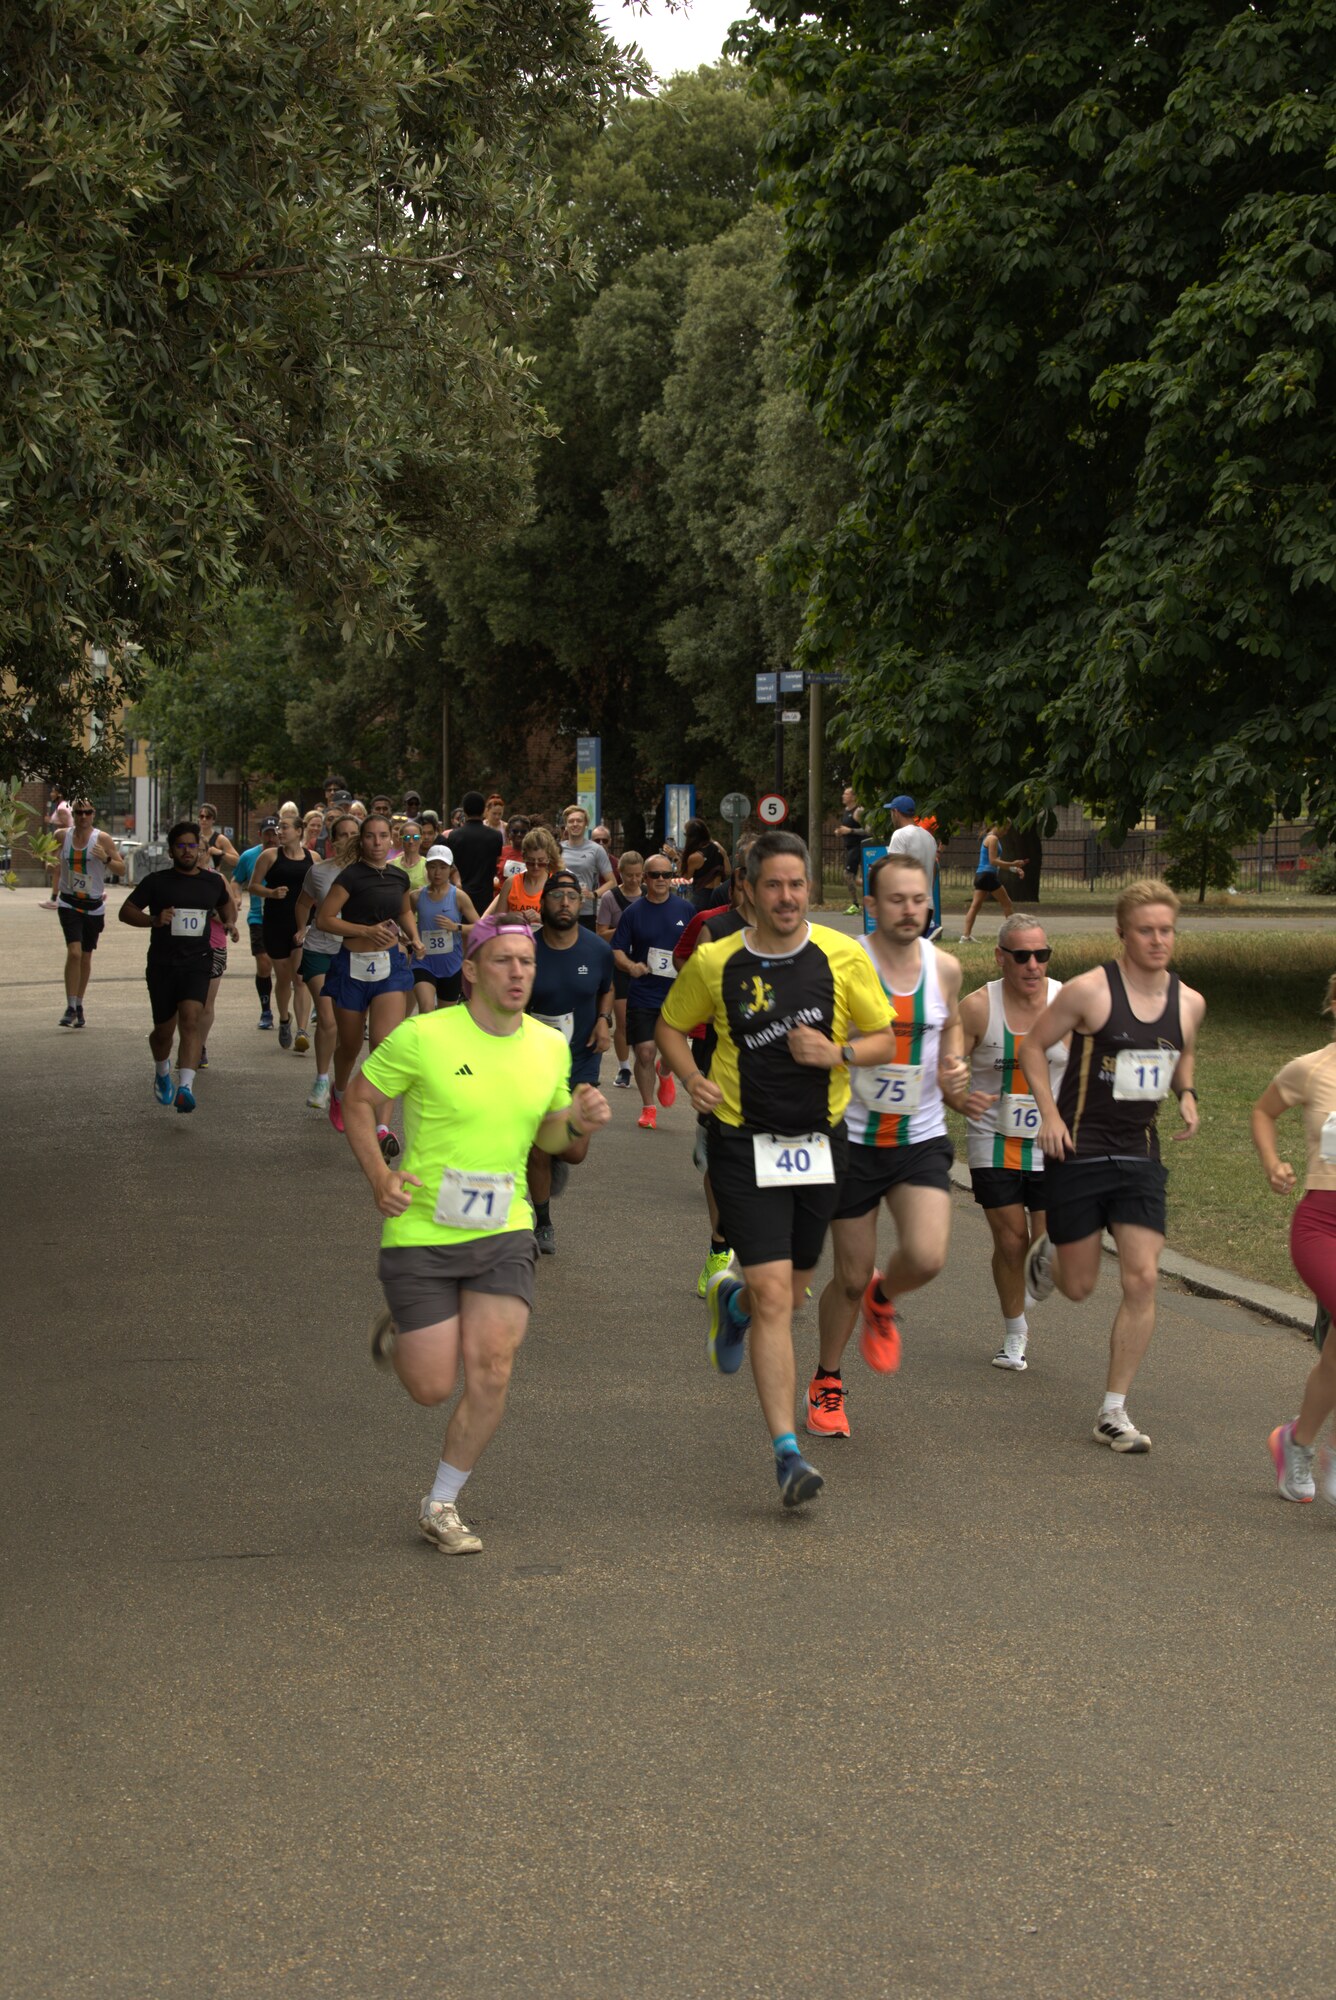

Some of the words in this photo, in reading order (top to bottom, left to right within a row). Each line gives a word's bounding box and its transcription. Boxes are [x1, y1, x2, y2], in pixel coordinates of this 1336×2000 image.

[768, 803, 777, 815] 5
[73, 878, 86, 889] 79
[182, 917, 198, 930] 10
[430, 937, 445, 949] 38
[366, 961, 376, 975] 4
[659, 958, 668, 970] 3
[1134, 1065, 1159, 1089] 11
[875, 1078, 906, 1103] 75
[1012, 1108, 1038, 1128] 16
[776, 1148, 811, 1172] 40
[462, 1188, 494, 1216] 71
